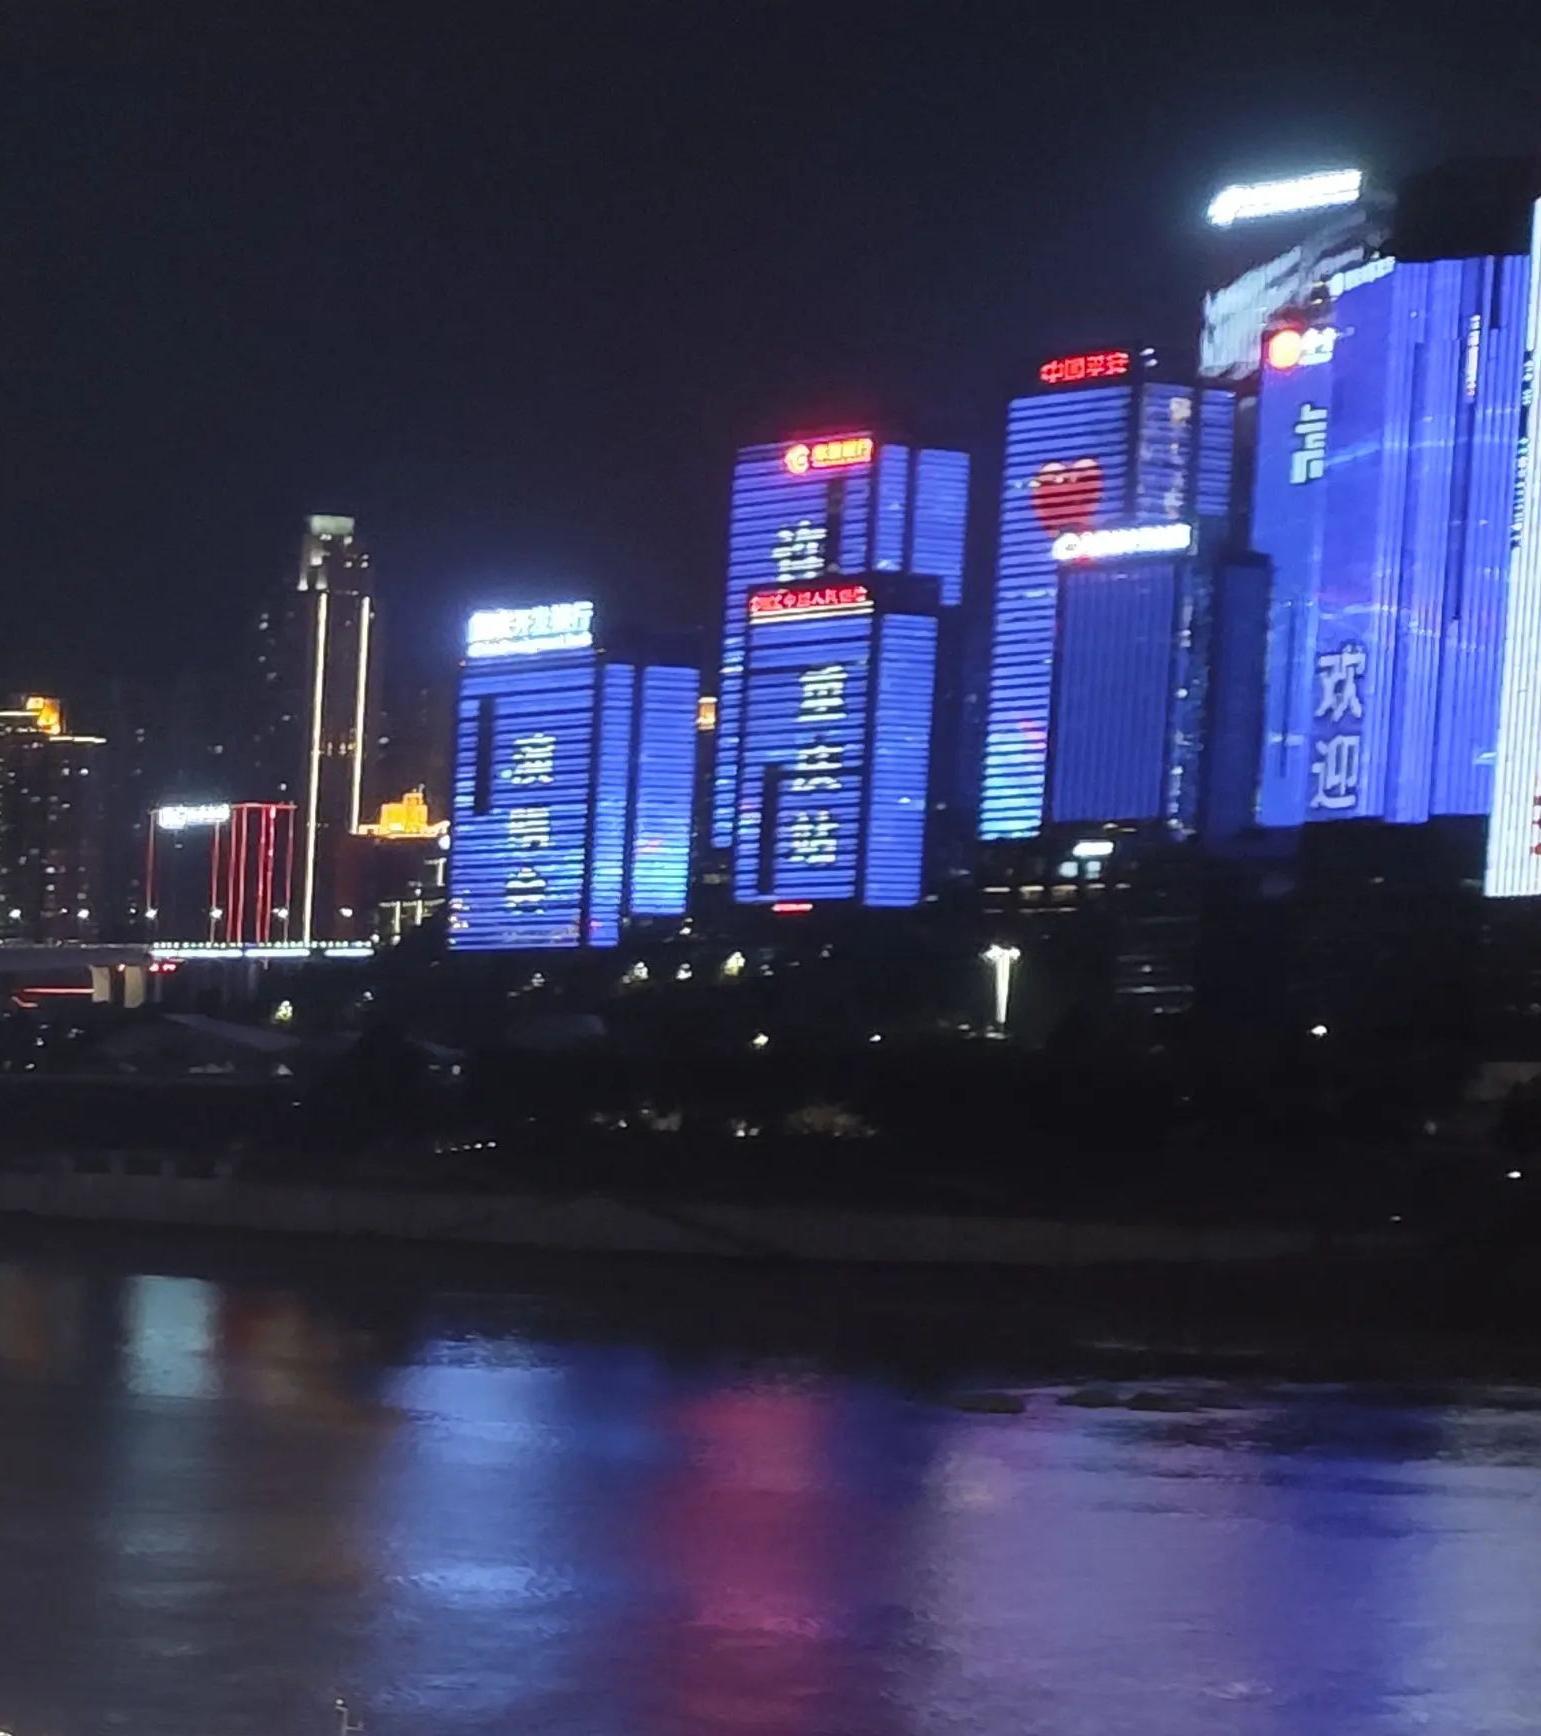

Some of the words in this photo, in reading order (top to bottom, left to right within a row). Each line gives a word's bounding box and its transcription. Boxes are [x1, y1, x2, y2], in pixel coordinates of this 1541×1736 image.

[1040, 351, 1130, 383] 中国平安
[1312, 642, 1367, 810] 欢迎
